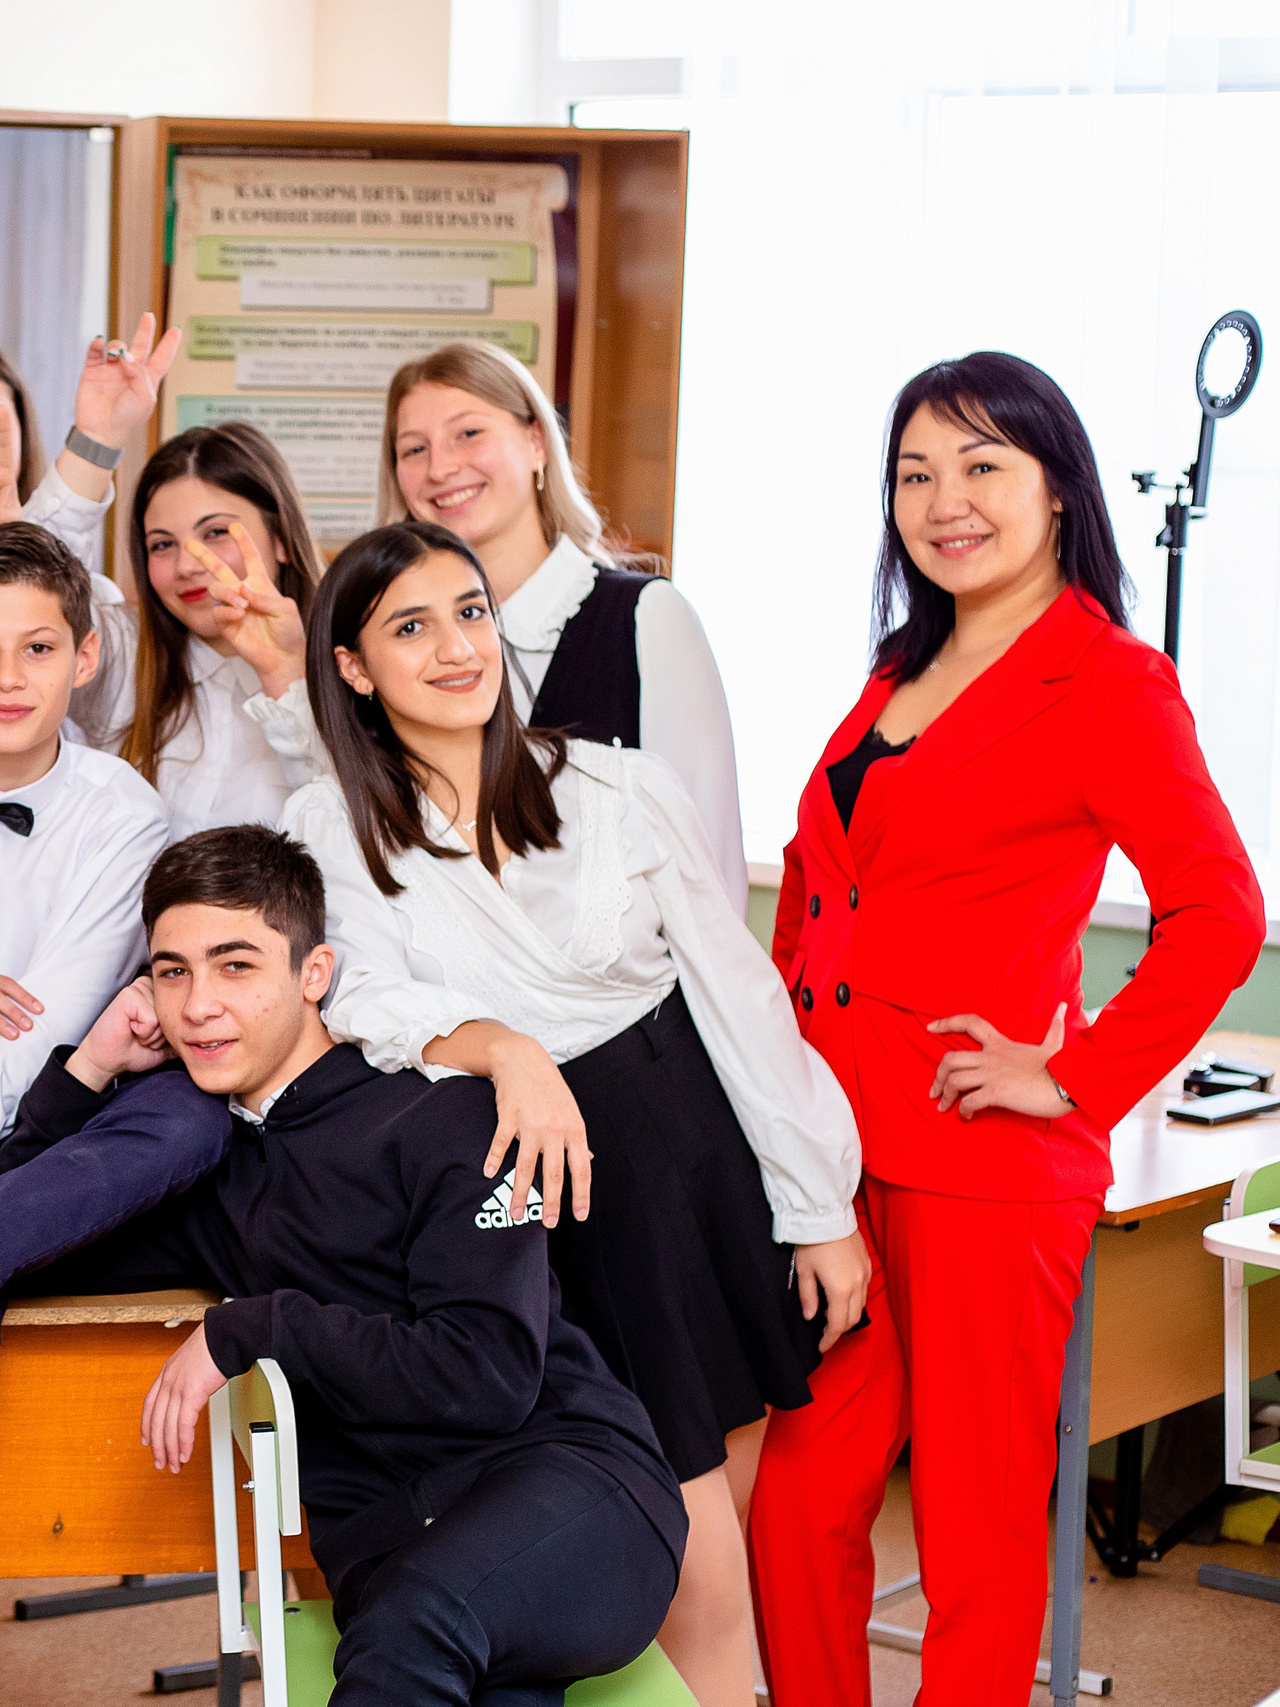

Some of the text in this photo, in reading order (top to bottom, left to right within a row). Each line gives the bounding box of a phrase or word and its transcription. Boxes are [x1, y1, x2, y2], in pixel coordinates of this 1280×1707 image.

[235, 184, 276, 200] КАК
[414, 187, 497, 206] ЦИТАТЫ
[211, 208, 223, 223] В
[361, 210, 391, 227] ПО
[397, 210, 517, 229] ЛИТЕРАТУРЕ
[475, 1203, 543, 1229] adia
